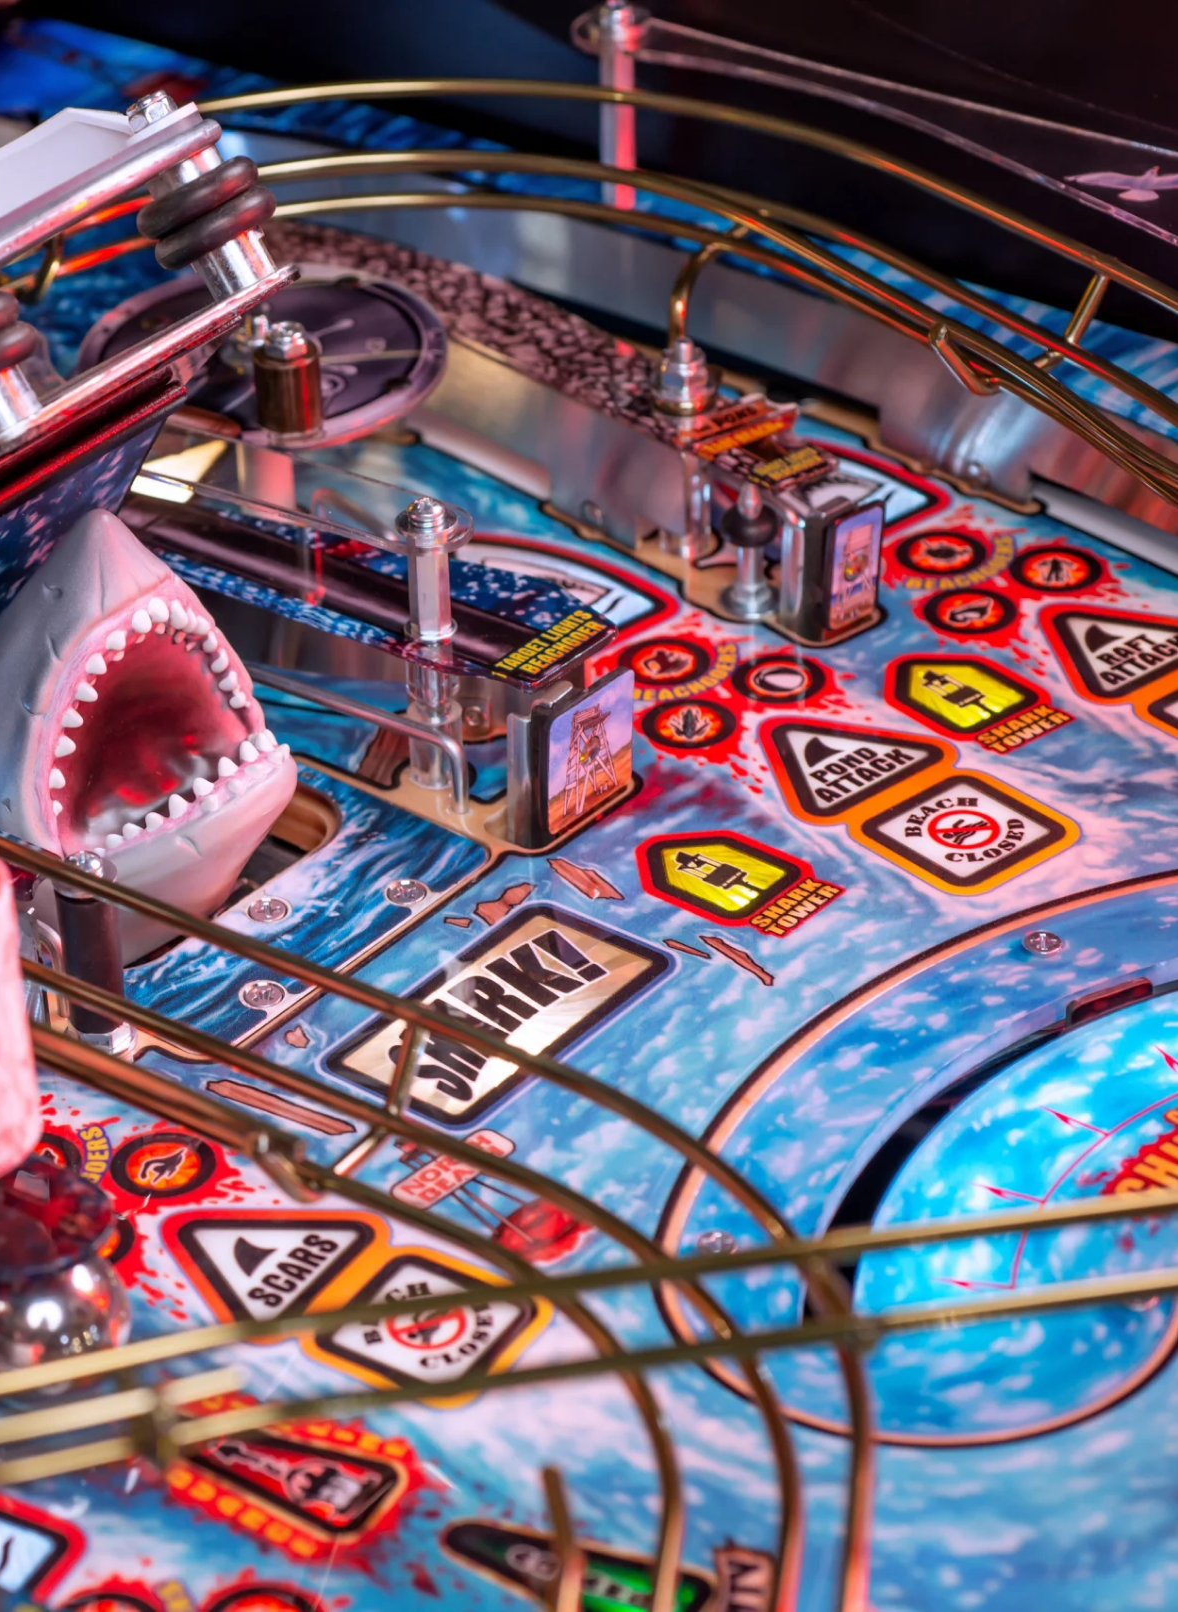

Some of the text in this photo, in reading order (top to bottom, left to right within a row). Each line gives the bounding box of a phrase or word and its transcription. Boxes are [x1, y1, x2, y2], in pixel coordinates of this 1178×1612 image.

[494, 609, 593, 672] TARGET LIGHTS
[519, 620, 608, 676] BEACHGOER
[1095, 633, 1158, 666] RAFT
[977, 704, 1056, 745] SHARK
[988, 711, 1072, 753] TOWER
[809, 747, 879, 783] POND
[814, 747, 915, 804] ATTACK
[904, 796, 979, 838] BEACH
[944, 818, 1025, 863] CLOSED
[750, 877, 823, 928] SHARK
[764, 884, 842, 936] TOWER
[247, 1233, 339, 1308] SCARS
[363, 1282, 432, 1345] BCH
[419, 1301, 493, 1368] CLOSE
